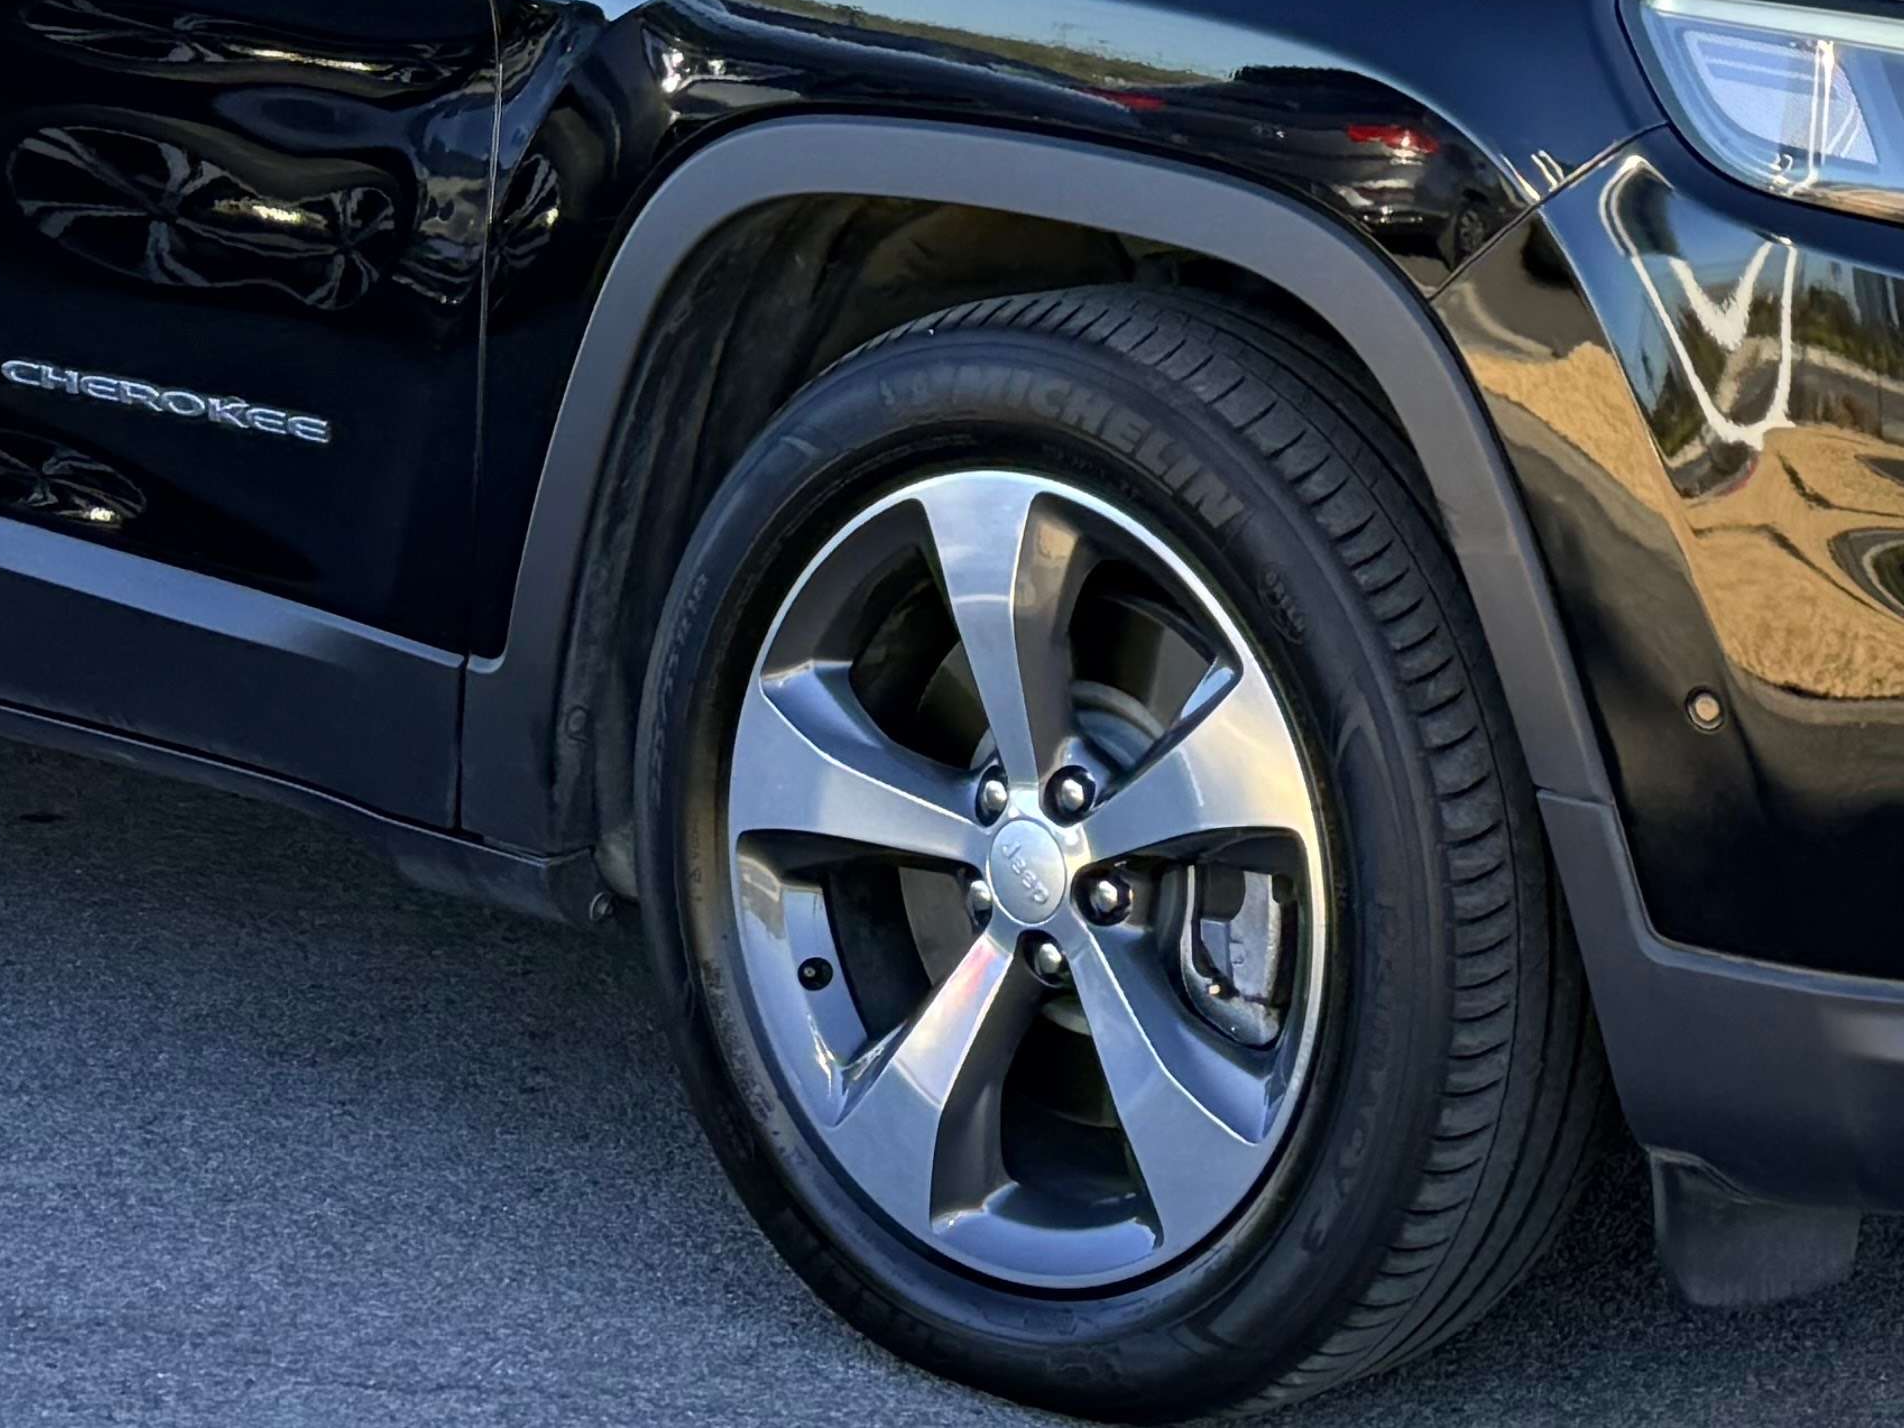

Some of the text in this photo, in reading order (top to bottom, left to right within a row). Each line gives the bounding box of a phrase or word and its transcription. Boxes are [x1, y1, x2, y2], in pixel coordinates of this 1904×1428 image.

[0, 358, 332, 444] CHEROKEE
[951, 363, 1245, 529] MICHELIN
[1001, 841, 1049, 904] Jeep
